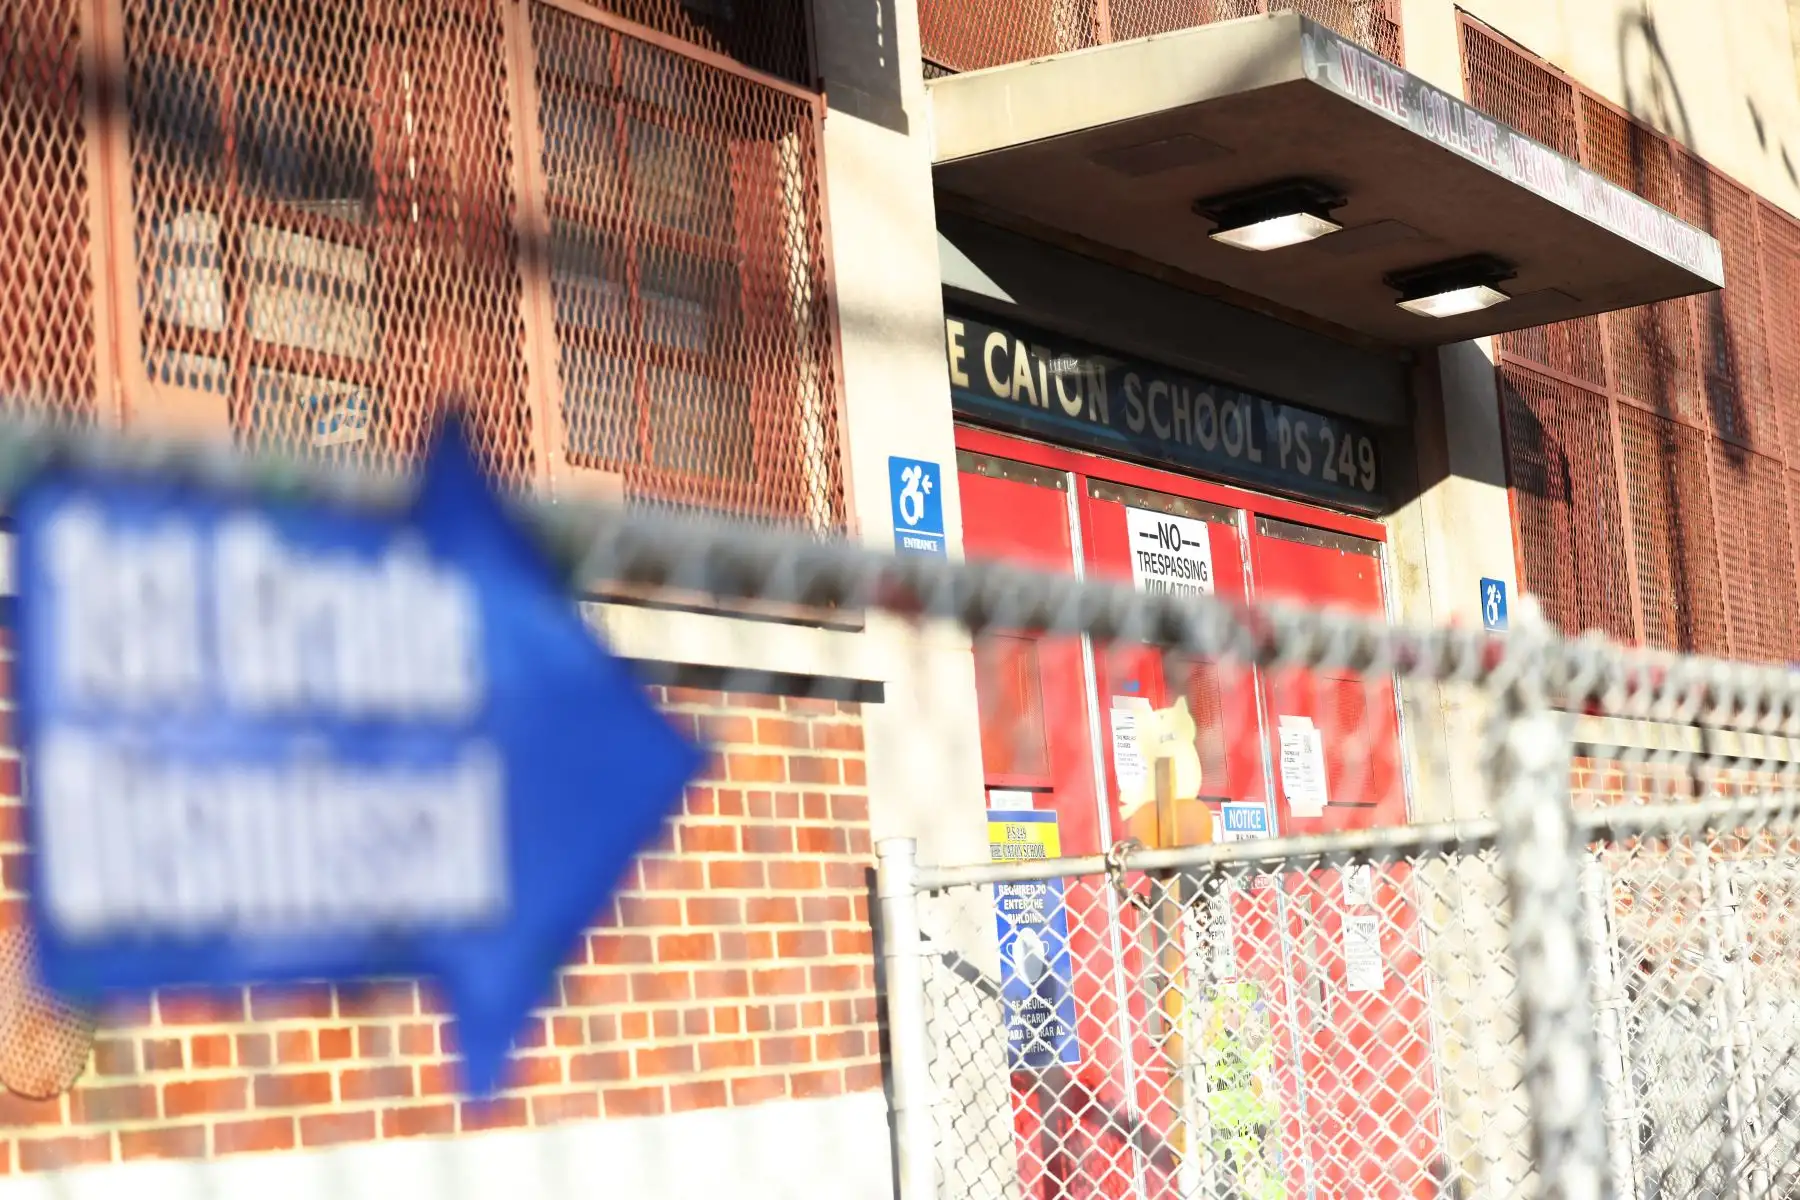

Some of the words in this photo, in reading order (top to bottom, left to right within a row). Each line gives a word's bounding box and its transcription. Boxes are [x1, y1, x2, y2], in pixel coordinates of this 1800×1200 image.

[1337, 39, 1409, 124] WHERE
[1419, 85, 1499, 167] COLLEGE
[983, 331, 1110, 425] CATON
[1123, 371, 1263, 464] SCHOOL
[1277, 413, 1312, 476] PS
[1319, 425, 1376, 493] 249
[903, 536, 938, 552] ENTRANCE
[1136, 550, 1208, 582] TRESPASSING
[1228, 808, 1262, 829] NOTICE
[1023, 844, 1046, 858] SCHOOL
[1004, 898, 1030, 910] ENTER
[1026, 1026, 1055, 1039] ERAR
[1056, 1025, 1066, 1037] AL
